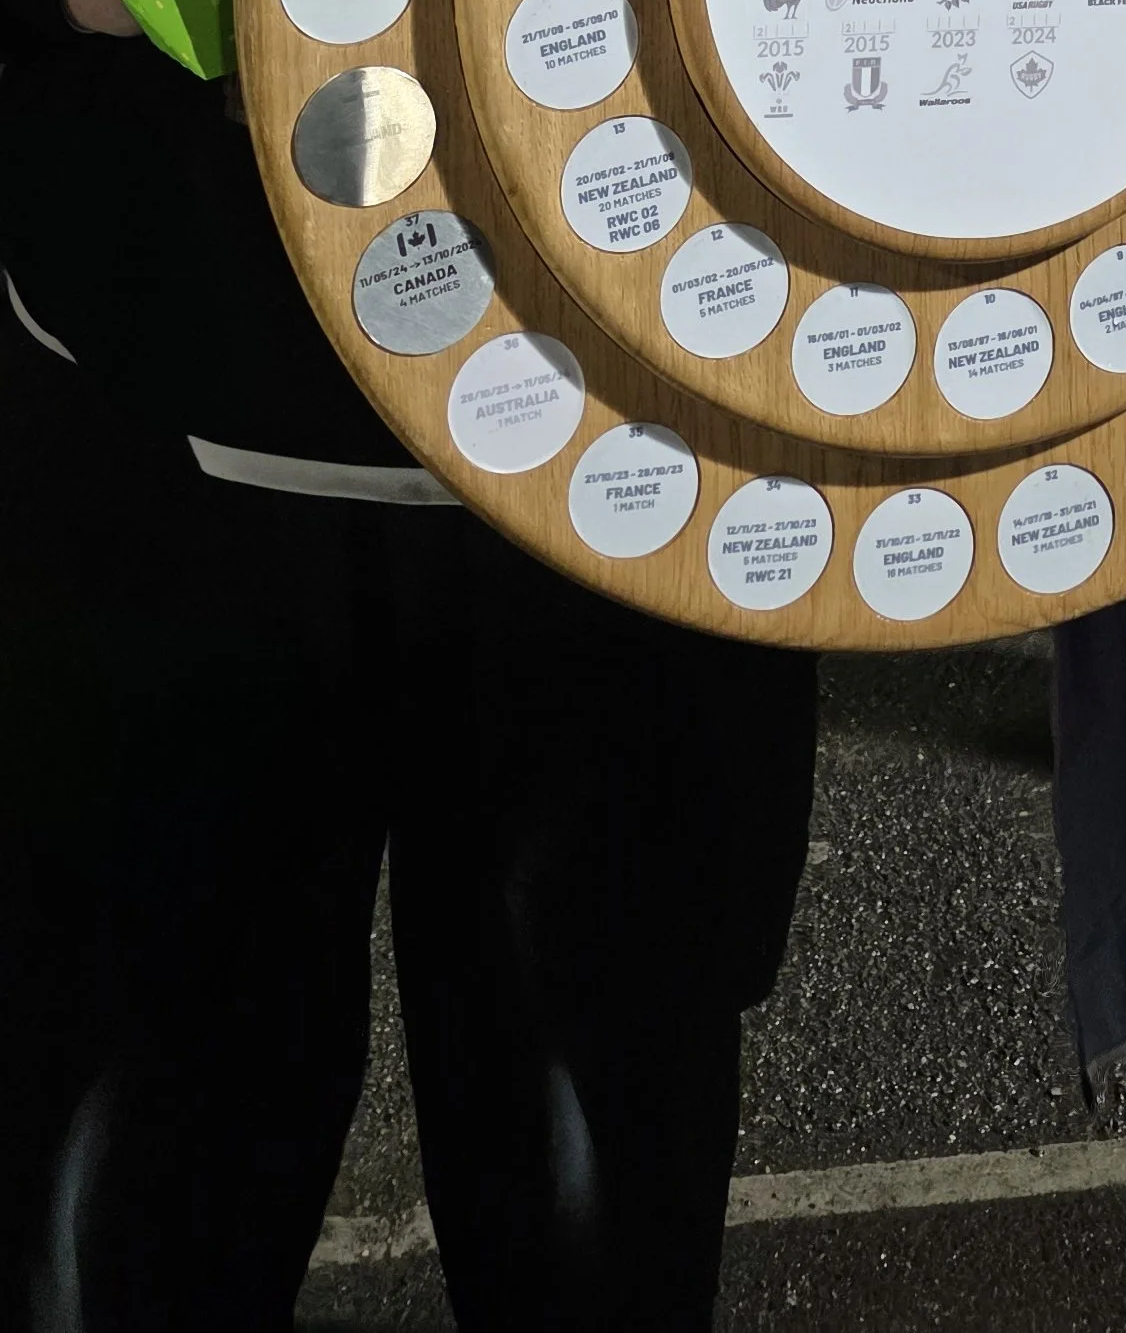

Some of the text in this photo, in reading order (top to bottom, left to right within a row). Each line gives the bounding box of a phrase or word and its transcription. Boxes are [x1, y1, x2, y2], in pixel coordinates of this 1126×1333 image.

[1012, 2, 1027, 10] USA
[540, 29, 606, 57] ENGLAND
[757, 27, 1057, 58] 2015 2015 2023 2024
[545, 45, 606, 69] 10 MATCHES
[919, 97, 971, 107] Wallaroos
[613, 123, 625, 134] 13
[578, 168, 677, 204] NEW ZEALAND
[405, 213, 420, 227] 37
[607, 205, 658, 229] RWC 02
[609, 219, 660, 243] RWC 06
[711, 229, 724, 241] 12
[394, 265, 457, 295] CANADA
[409, 280, 460, 305] MATCHES
[698, 279, 753, 305] FRANCE
[984, 295, 996, 304] 10
[700, 295, 755, 317] 5 MATCHES
[824, 340, 886, 360] ENGLAND
[949, 341, 1039, 369] NEW ZEALAND
[828, 356, 882, 372] 3 MATCHES
[476, 389, 559, 420] AUSTRALIA
[629, 427, 642, 438] 35
[1045, 472, 1058, 481] 32
[606, 483, 660, 500] FRANCE
[766, 481, 780, 491] 34
[614, 499, 654, 512] 1 MATCH
[908, 494, 921, 504] 33
[1012, 515, 1099, 546] NEW ZEALAND
[722, 535, 817, 554] NEW ZEALAND
[884, 547, 944, 565] ENGLAND
[746, 568, 791, 583] RWC 21
